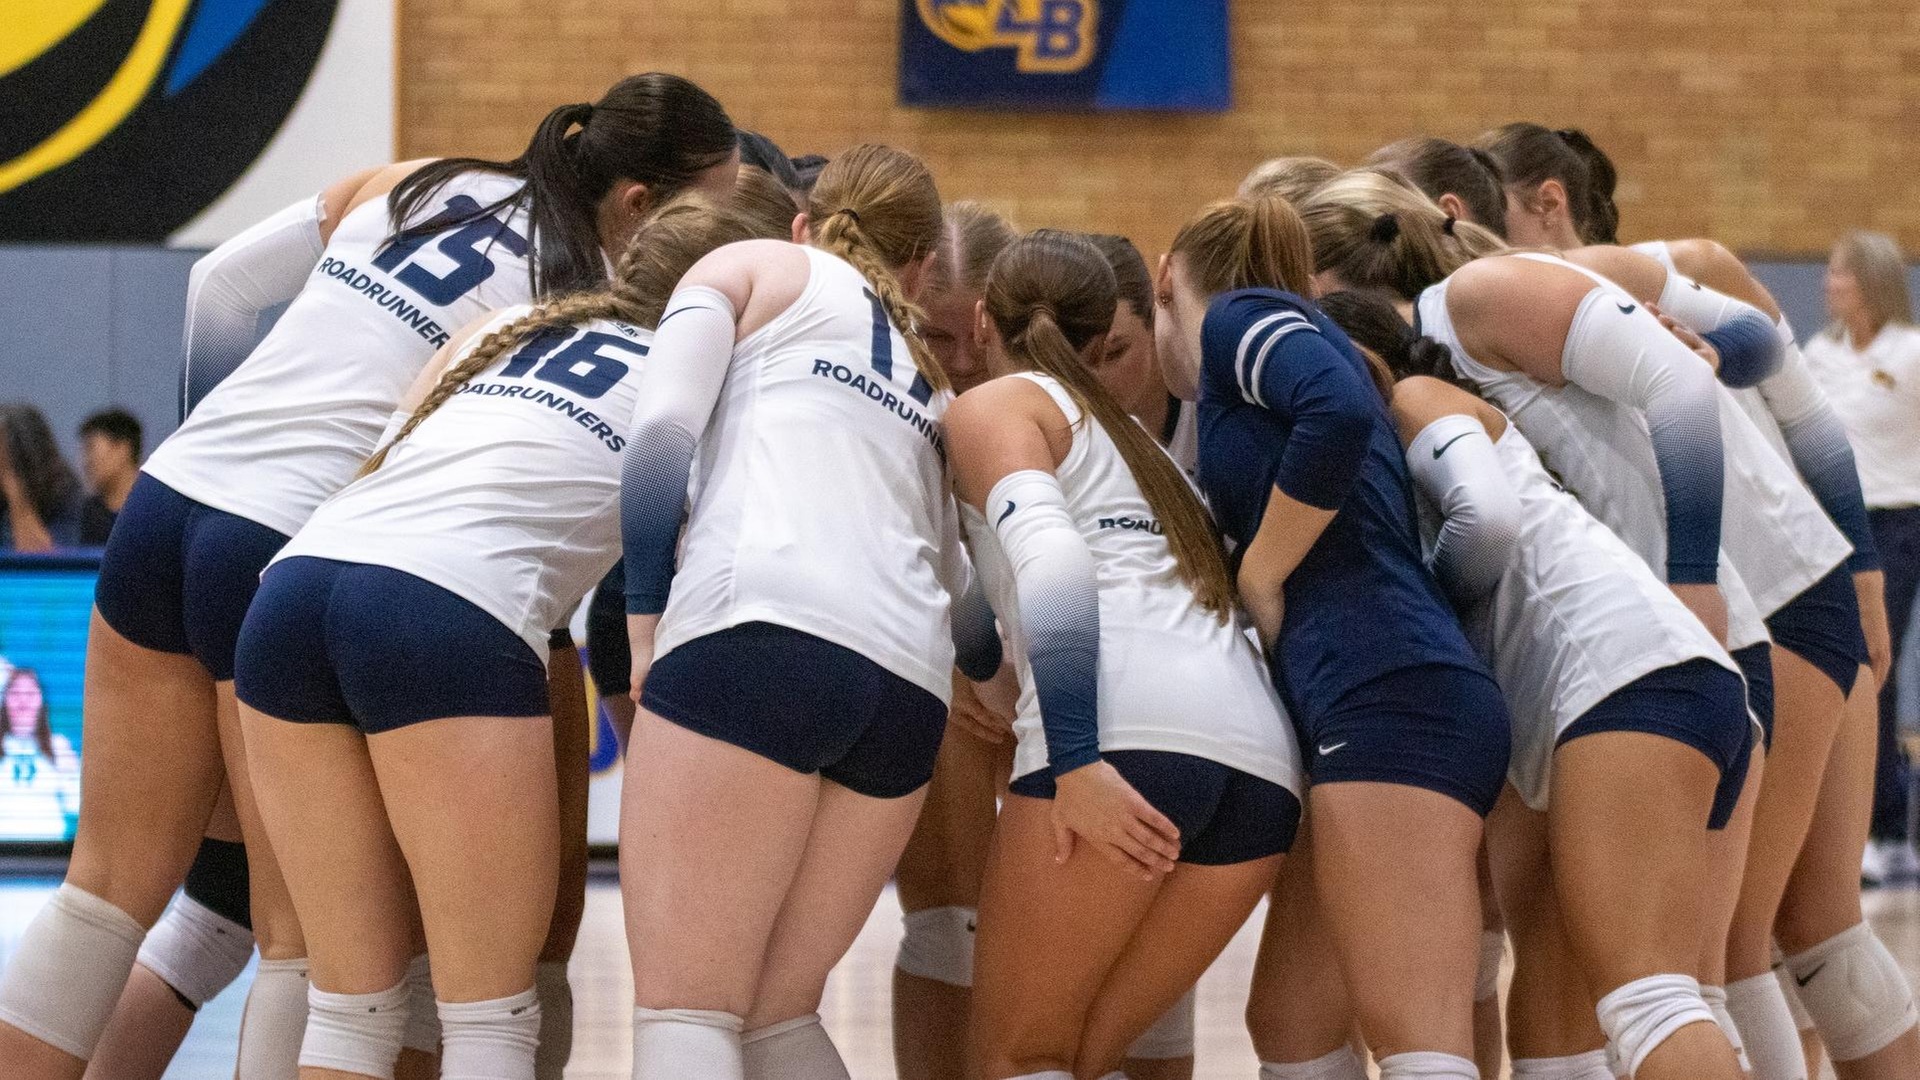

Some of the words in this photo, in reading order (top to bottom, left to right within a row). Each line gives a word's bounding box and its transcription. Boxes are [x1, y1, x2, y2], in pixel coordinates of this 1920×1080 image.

[371, 194, 535, 307] 15
[497, 325, 650, 399] 16
[863, 285, 933, 408] 1
